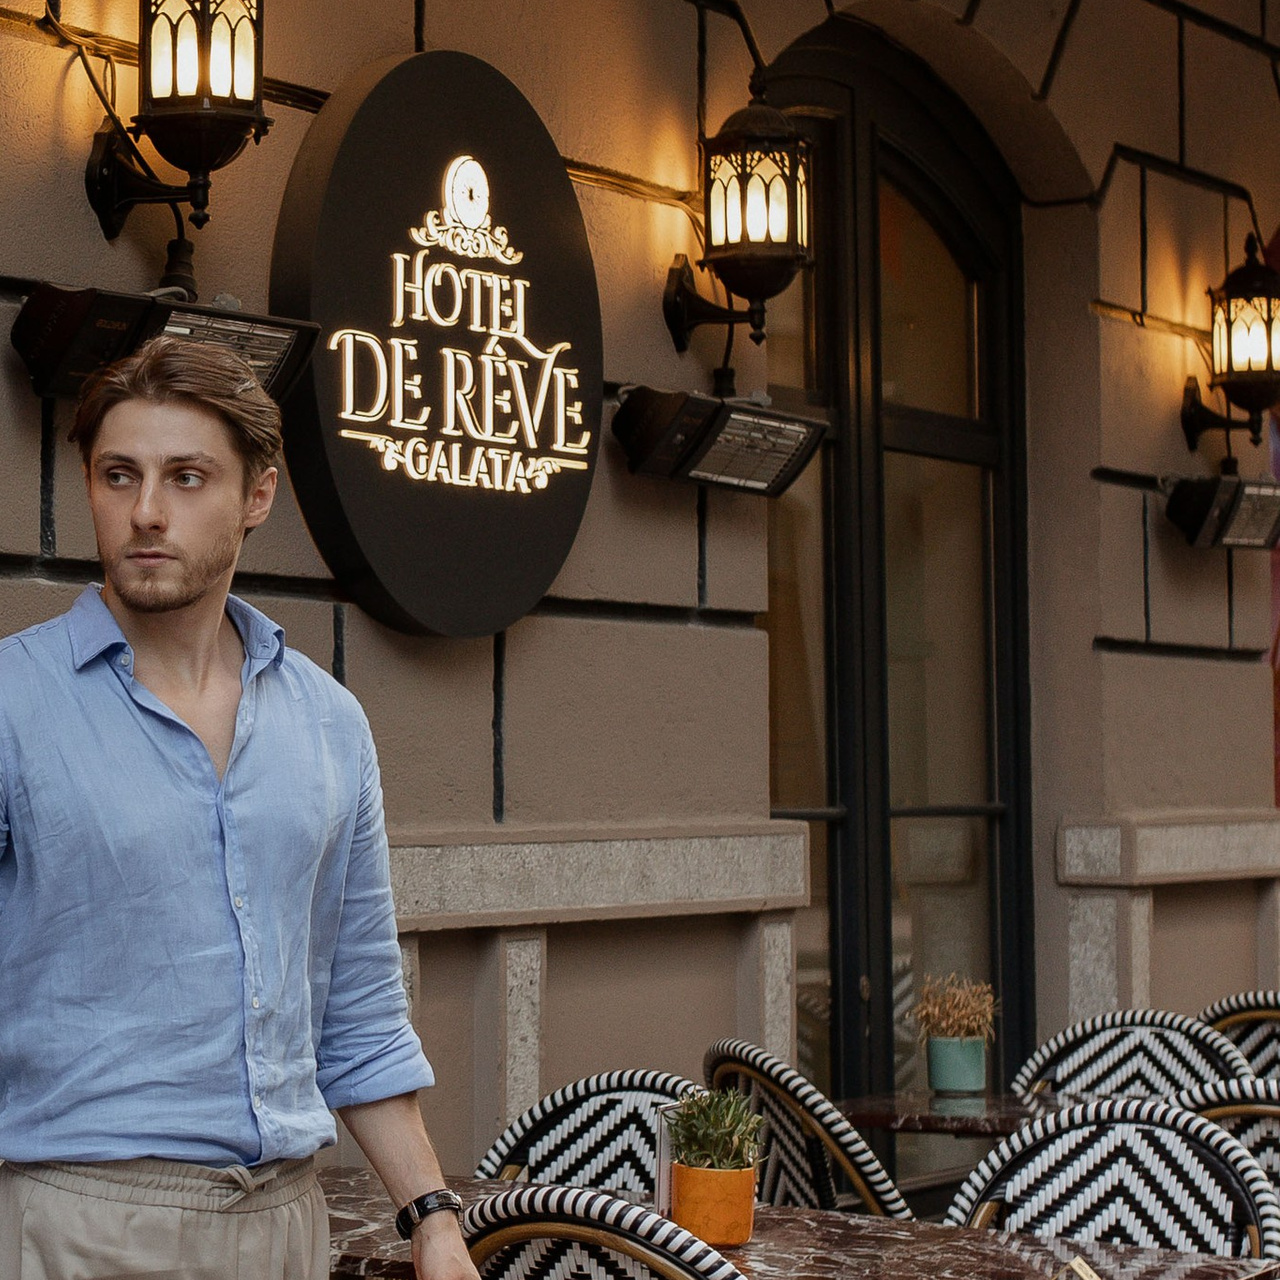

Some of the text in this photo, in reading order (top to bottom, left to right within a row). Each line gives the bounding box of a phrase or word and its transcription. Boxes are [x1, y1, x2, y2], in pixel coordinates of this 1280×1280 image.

[390, 249, 531, 338] HOTEL
[327, 328, 592, 455] DE RÊVE
[403, 436, 532, 494] GALATA
